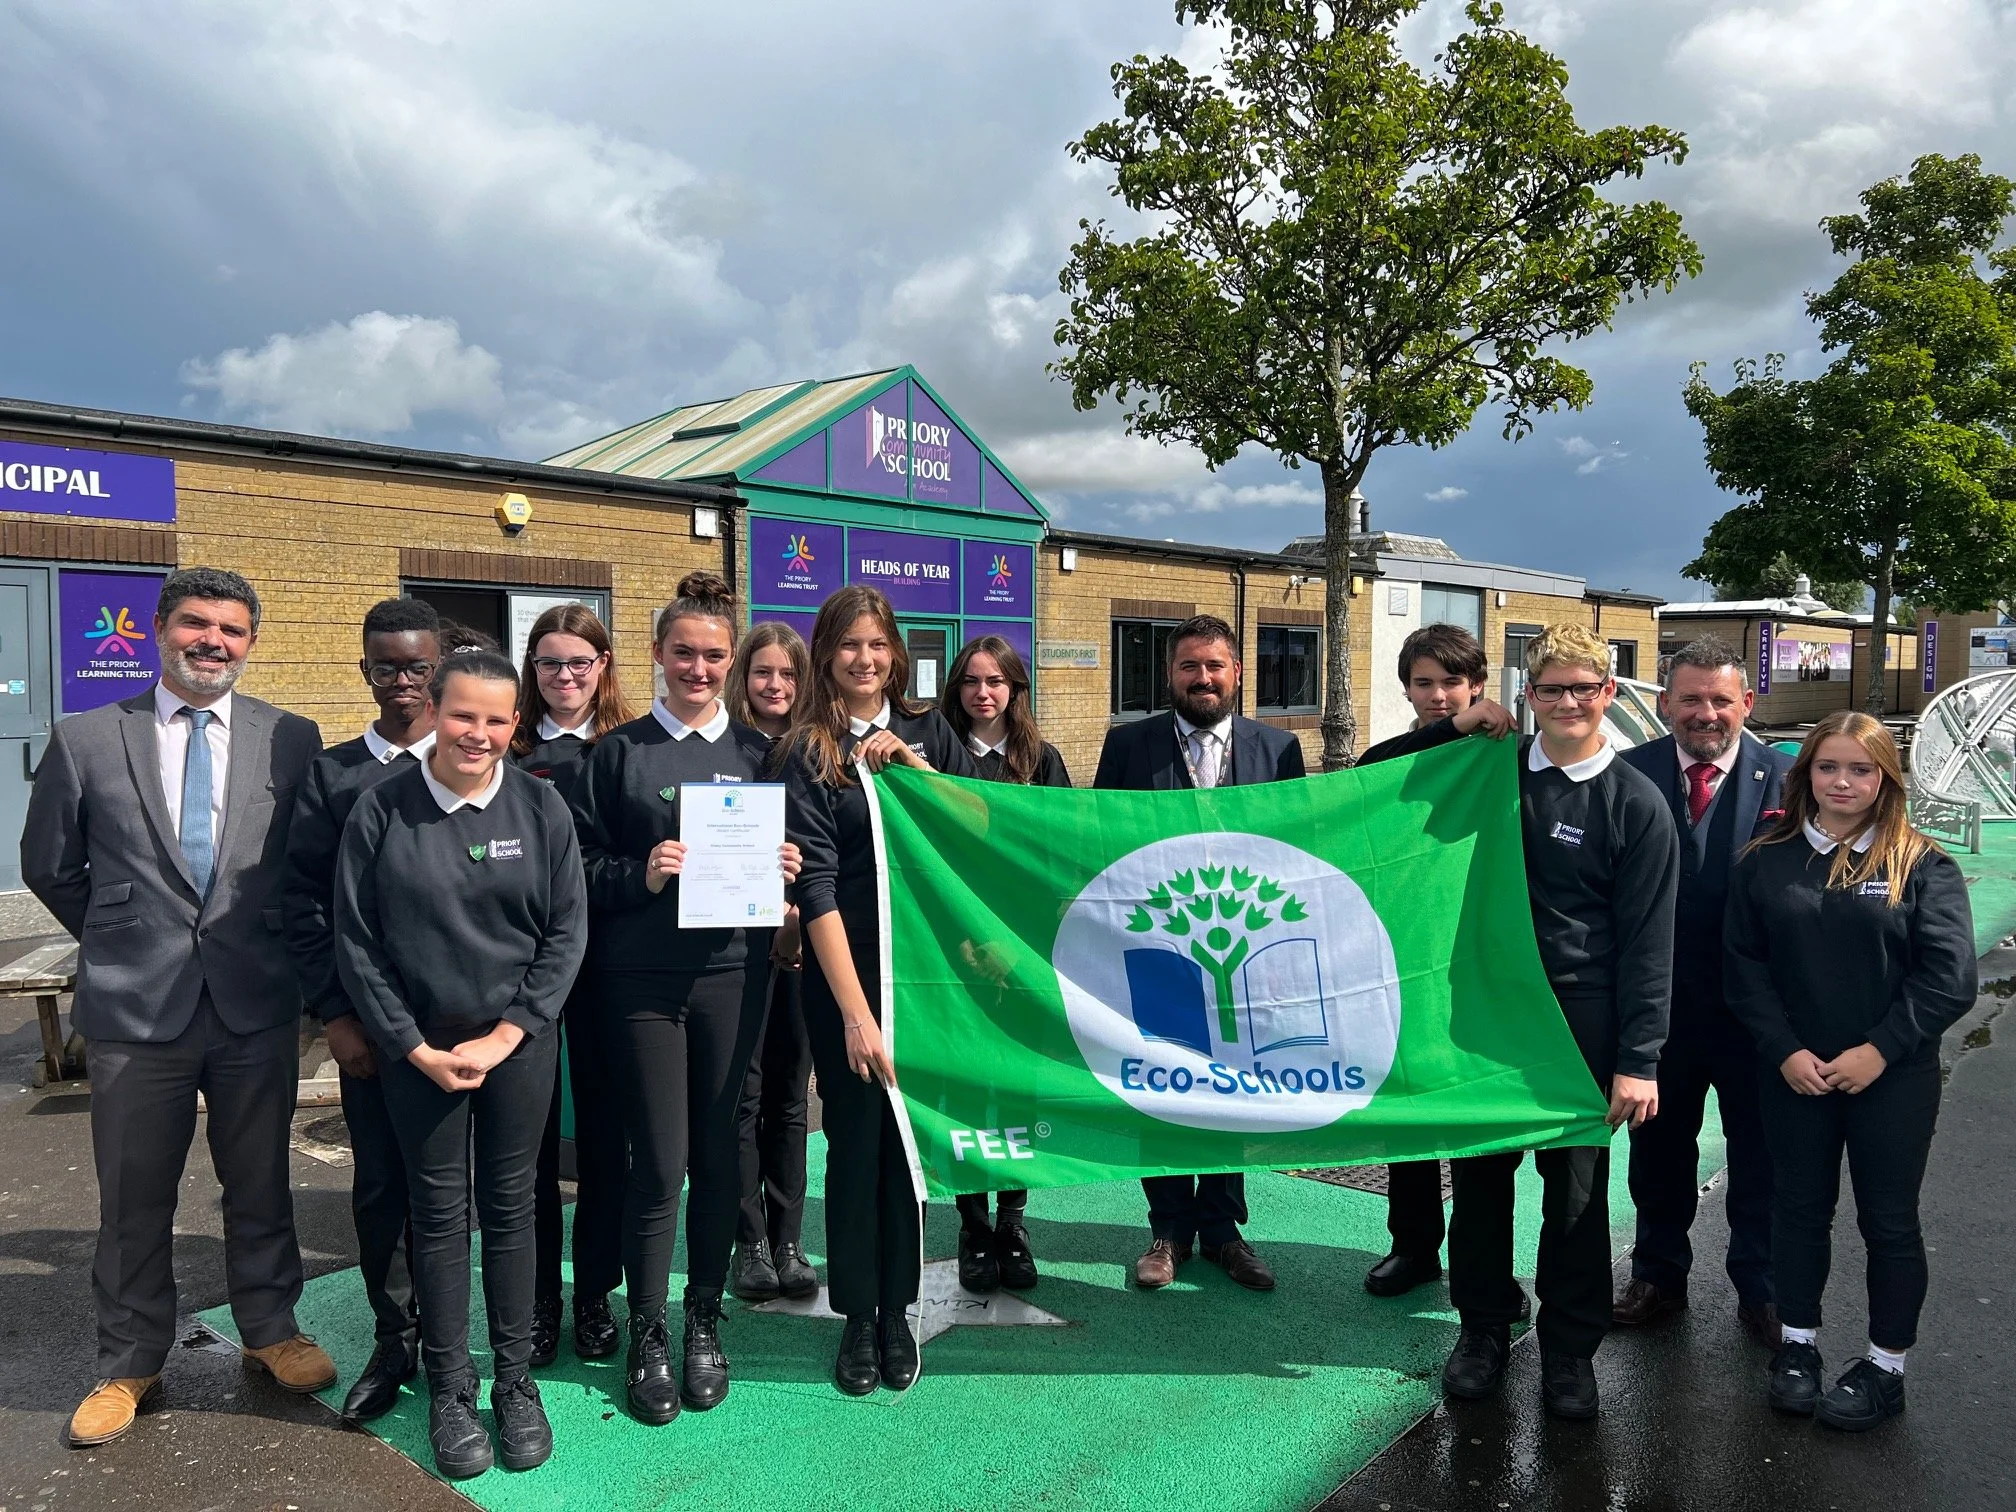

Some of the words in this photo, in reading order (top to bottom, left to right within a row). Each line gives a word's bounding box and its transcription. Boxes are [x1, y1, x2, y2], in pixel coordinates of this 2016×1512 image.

[888, 416, 951, 447] PRIORY
[888, 454, 951, 481] SCHOOL
[0, 462, 111, 498] CIPAL
[861, 559, 901, 576] HEADS
[904, 562, 920, 577] OF
[922, 564, 950, 579] YEAR
[795, 575, 811, 583] PRIORY
[893, 577, 921, 586] BUILDING
[778, 582, 802, 590] LEARNING
[803, 583, 818, 591] TRUST
[1042, 648, 1079, 658] STUDENTS
[1080, 649, 1097, 659] FIRST
[1761, 629, 1769, 688] CREATIVE
[1925, 634, 1935, 680] DESIGN
[89, 660, 108, 668] THE
[109, 660, 140, 668] PRIORY
[77, 670, 123, 678] LEARNING
[123, 670, 154, 678] TRUST
[721, 774, 742, 783] PRIORY
[1562, 824, 1585, 836] PRIORY
[496, 839, 521, 848] PRIORY
[1558, 833, 1582, 845] SCHOOL
[497, 848, 523, 857] SCHOOL
[1120, 1057, 1366, 1095] Eco-Schools
[949, 1126, 1035, 1161] FEE
